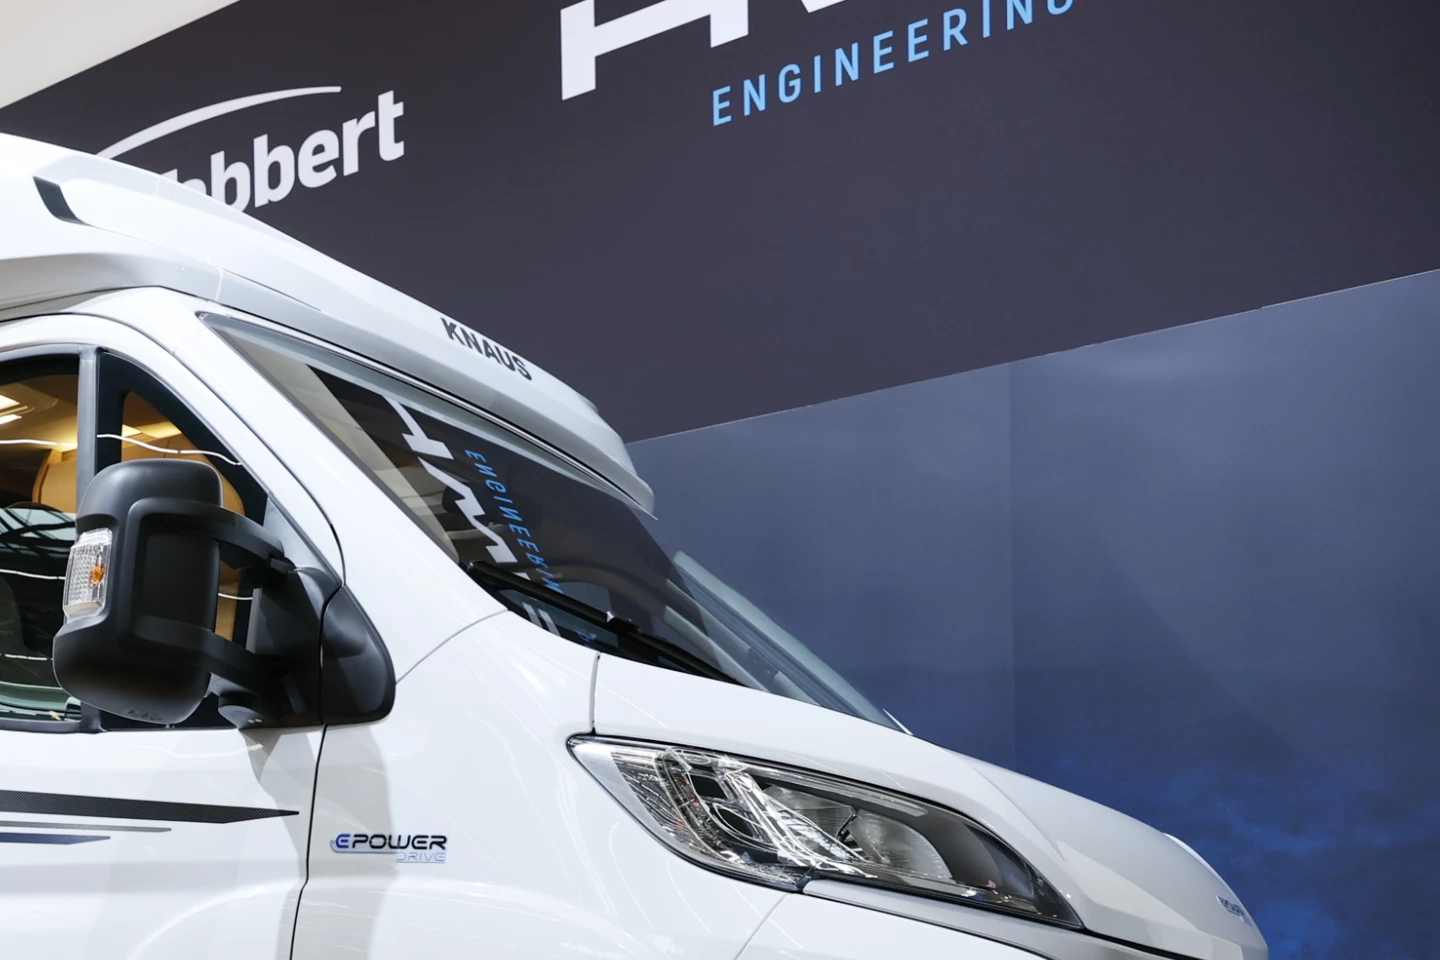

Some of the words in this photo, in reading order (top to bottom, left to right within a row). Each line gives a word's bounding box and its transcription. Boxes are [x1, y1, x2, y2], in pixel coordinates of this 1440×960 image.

[160, 90, 404, 213] bbert
[440, 316, 532, 381] KNAUS
[396, 852, 445, 862] DRIVE
